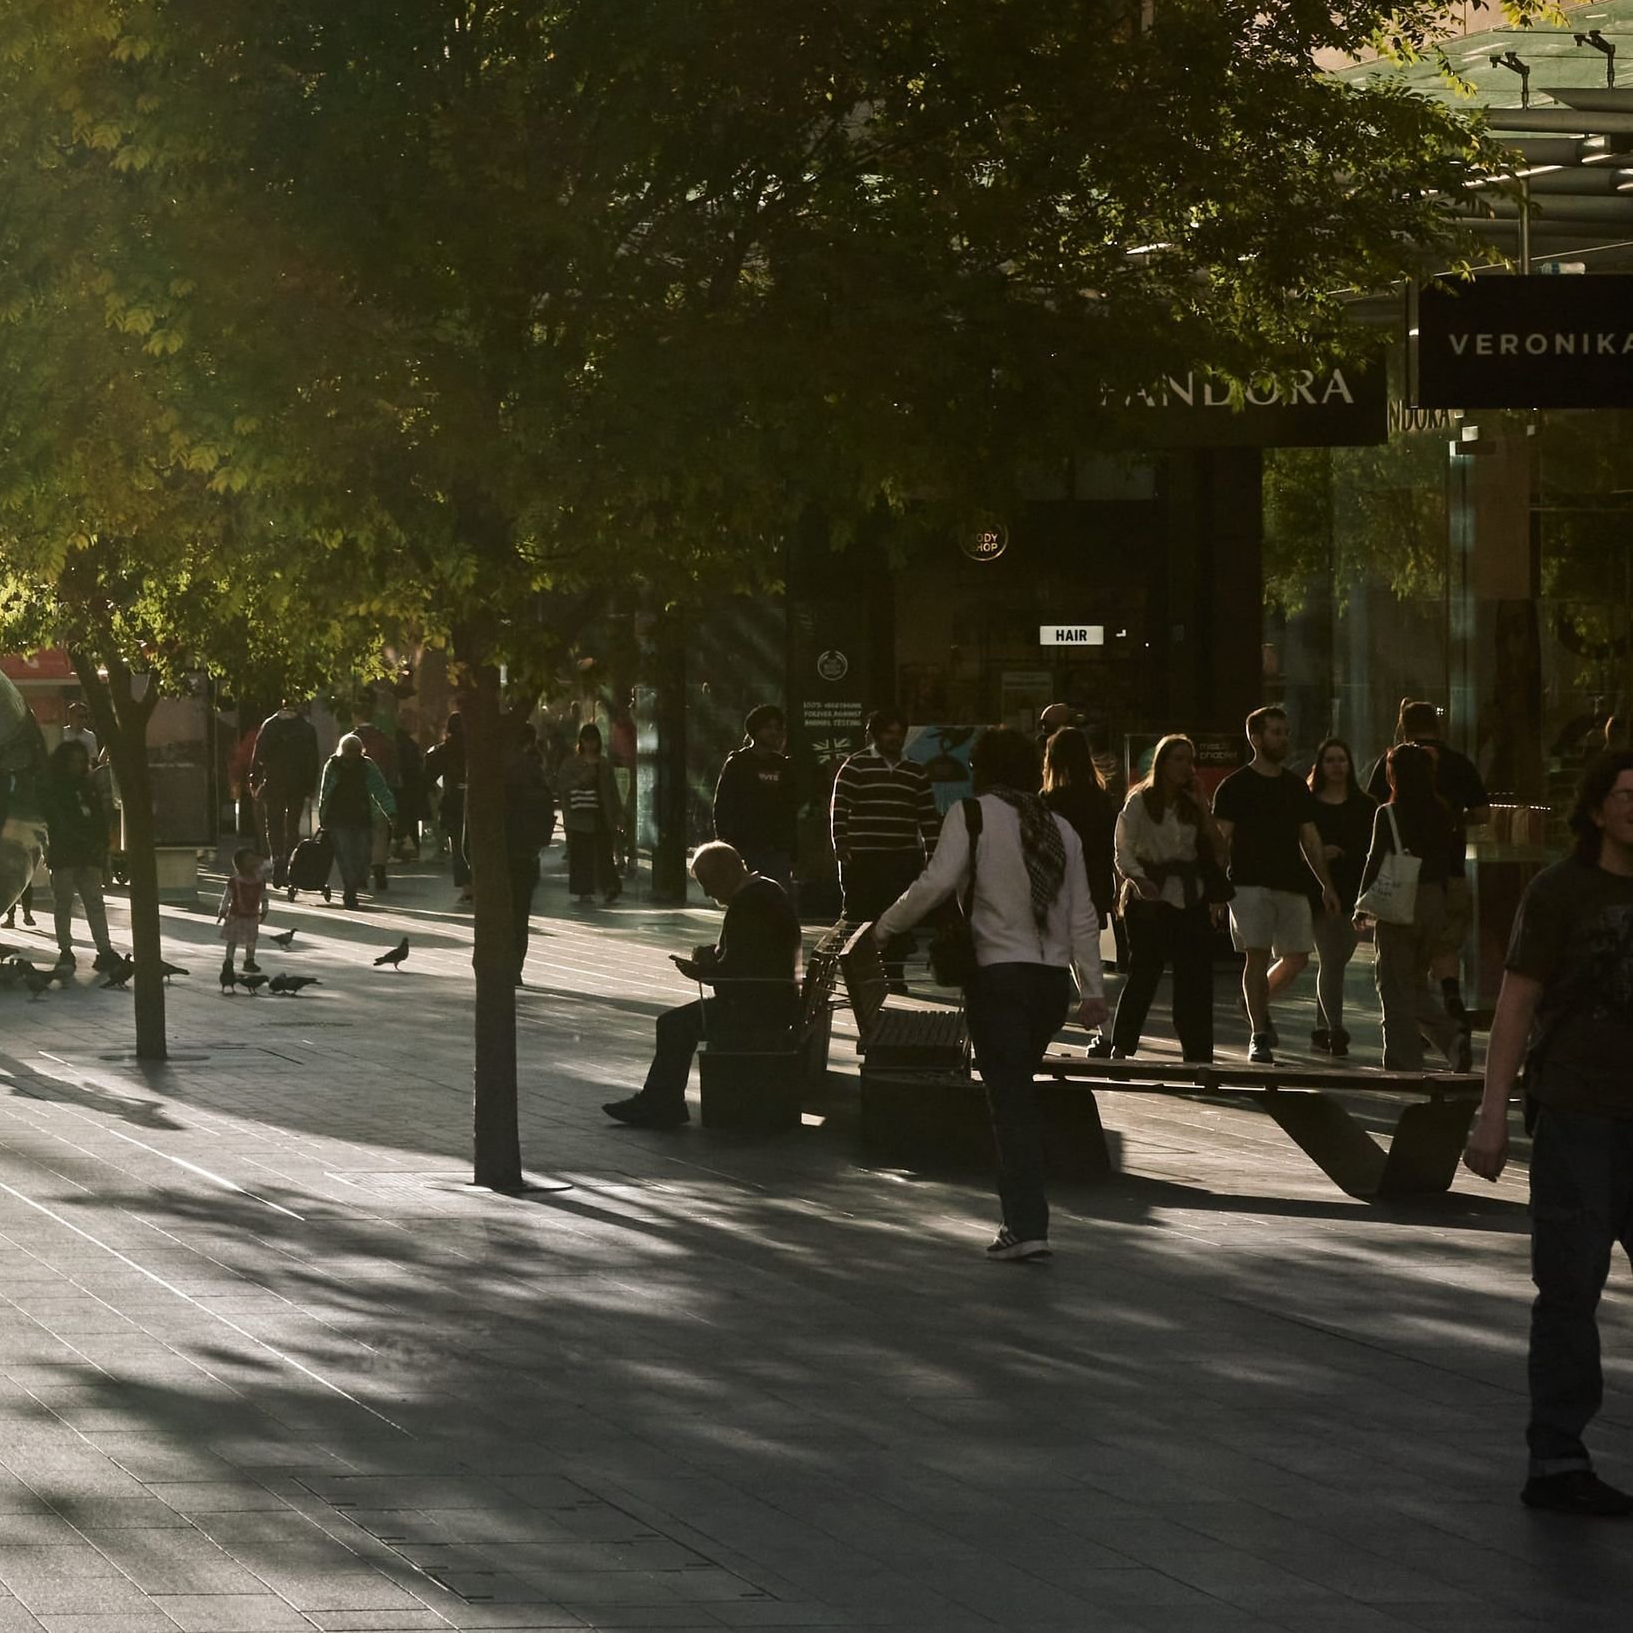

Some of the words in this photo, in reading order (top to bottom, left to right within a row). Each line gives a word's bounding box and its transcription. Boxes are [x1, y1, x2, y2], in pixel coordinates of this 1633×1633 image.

[1447, 332, 1633, 356] VERONIKA
[1099, 367, 1355, 407] ANDORA
[1387, 399, 1452, 433] NDORA
[975, 532, 998, 543] ODY
[976, 542, 998, 553] HOP
[1056, 629, 1088, 642] HAIR
